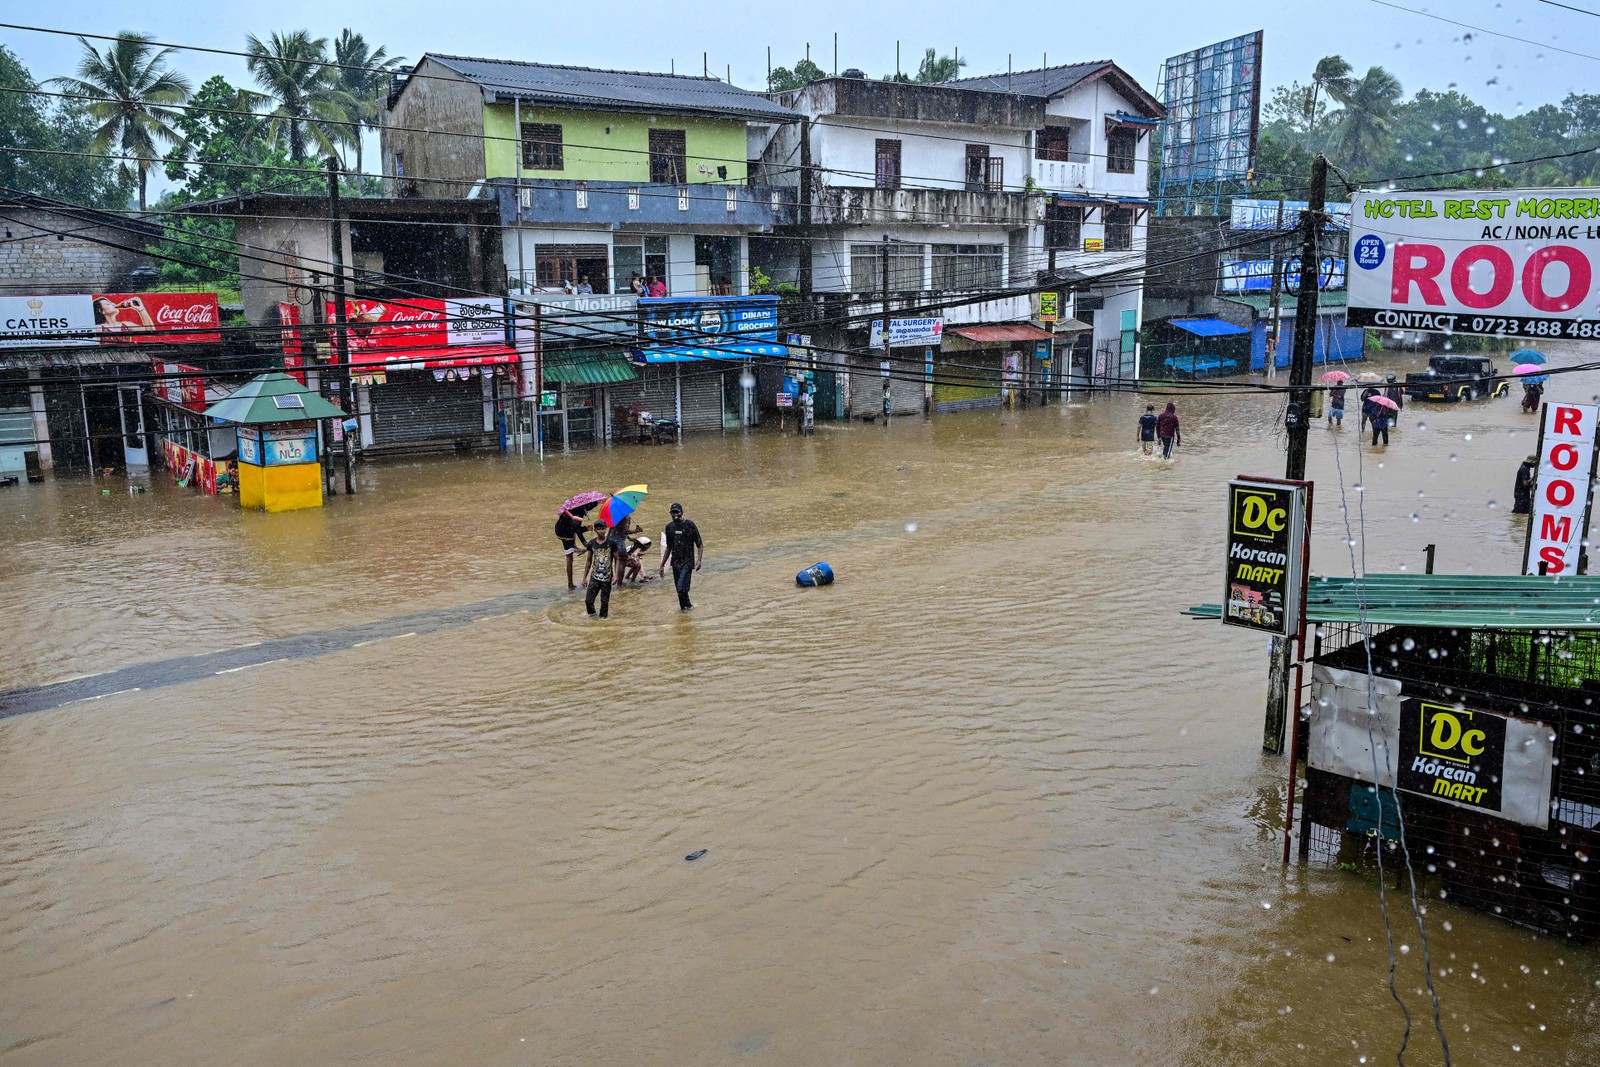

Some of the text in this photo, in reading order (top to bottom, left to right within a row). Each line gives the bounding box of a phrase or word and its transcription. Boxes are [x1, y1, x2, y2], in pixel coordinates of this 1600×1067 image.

[1364, 197, 1600, 220] HOTEL REST MORRI
[1481, 226, 1502, 239] AC
[1505, 226, 1512, 240] /
[1515, 226, 1551, 239] NON
[1556, 226, 1579, 239] AC
[1360, 246, 1378, 258] 24
[1390, 243, 1592, 313] ROO
[157, 304, 214, 324] Coca-Cola
[574, 297, 632, 311] Mobile
[6, 318, 69, 329] CATERS
[668, 318, 696, 326] LOOK
[738, 321, 775, 331] GROCERY
[873, 319, 937, 328] DETAL SURGERY
[1374, 311, 1458, 329] CONTACT
[1472, 317, 1519, 333] 0723
[1524, 320, 1562, 336] 488
[1566, 322, 1600, 338] 488
[1537, 407, 1583, 574] ROOMS
[1242, 495, 1287, 532] Dc
[1230, 542, 1287, 566] Korean
[1236, 563, 1284, 585] MART
[1430, 712, 1486, 756] Dc
[1411, 756, 1477, 785] Korean
[1432, 778, 1488, 804] MART
